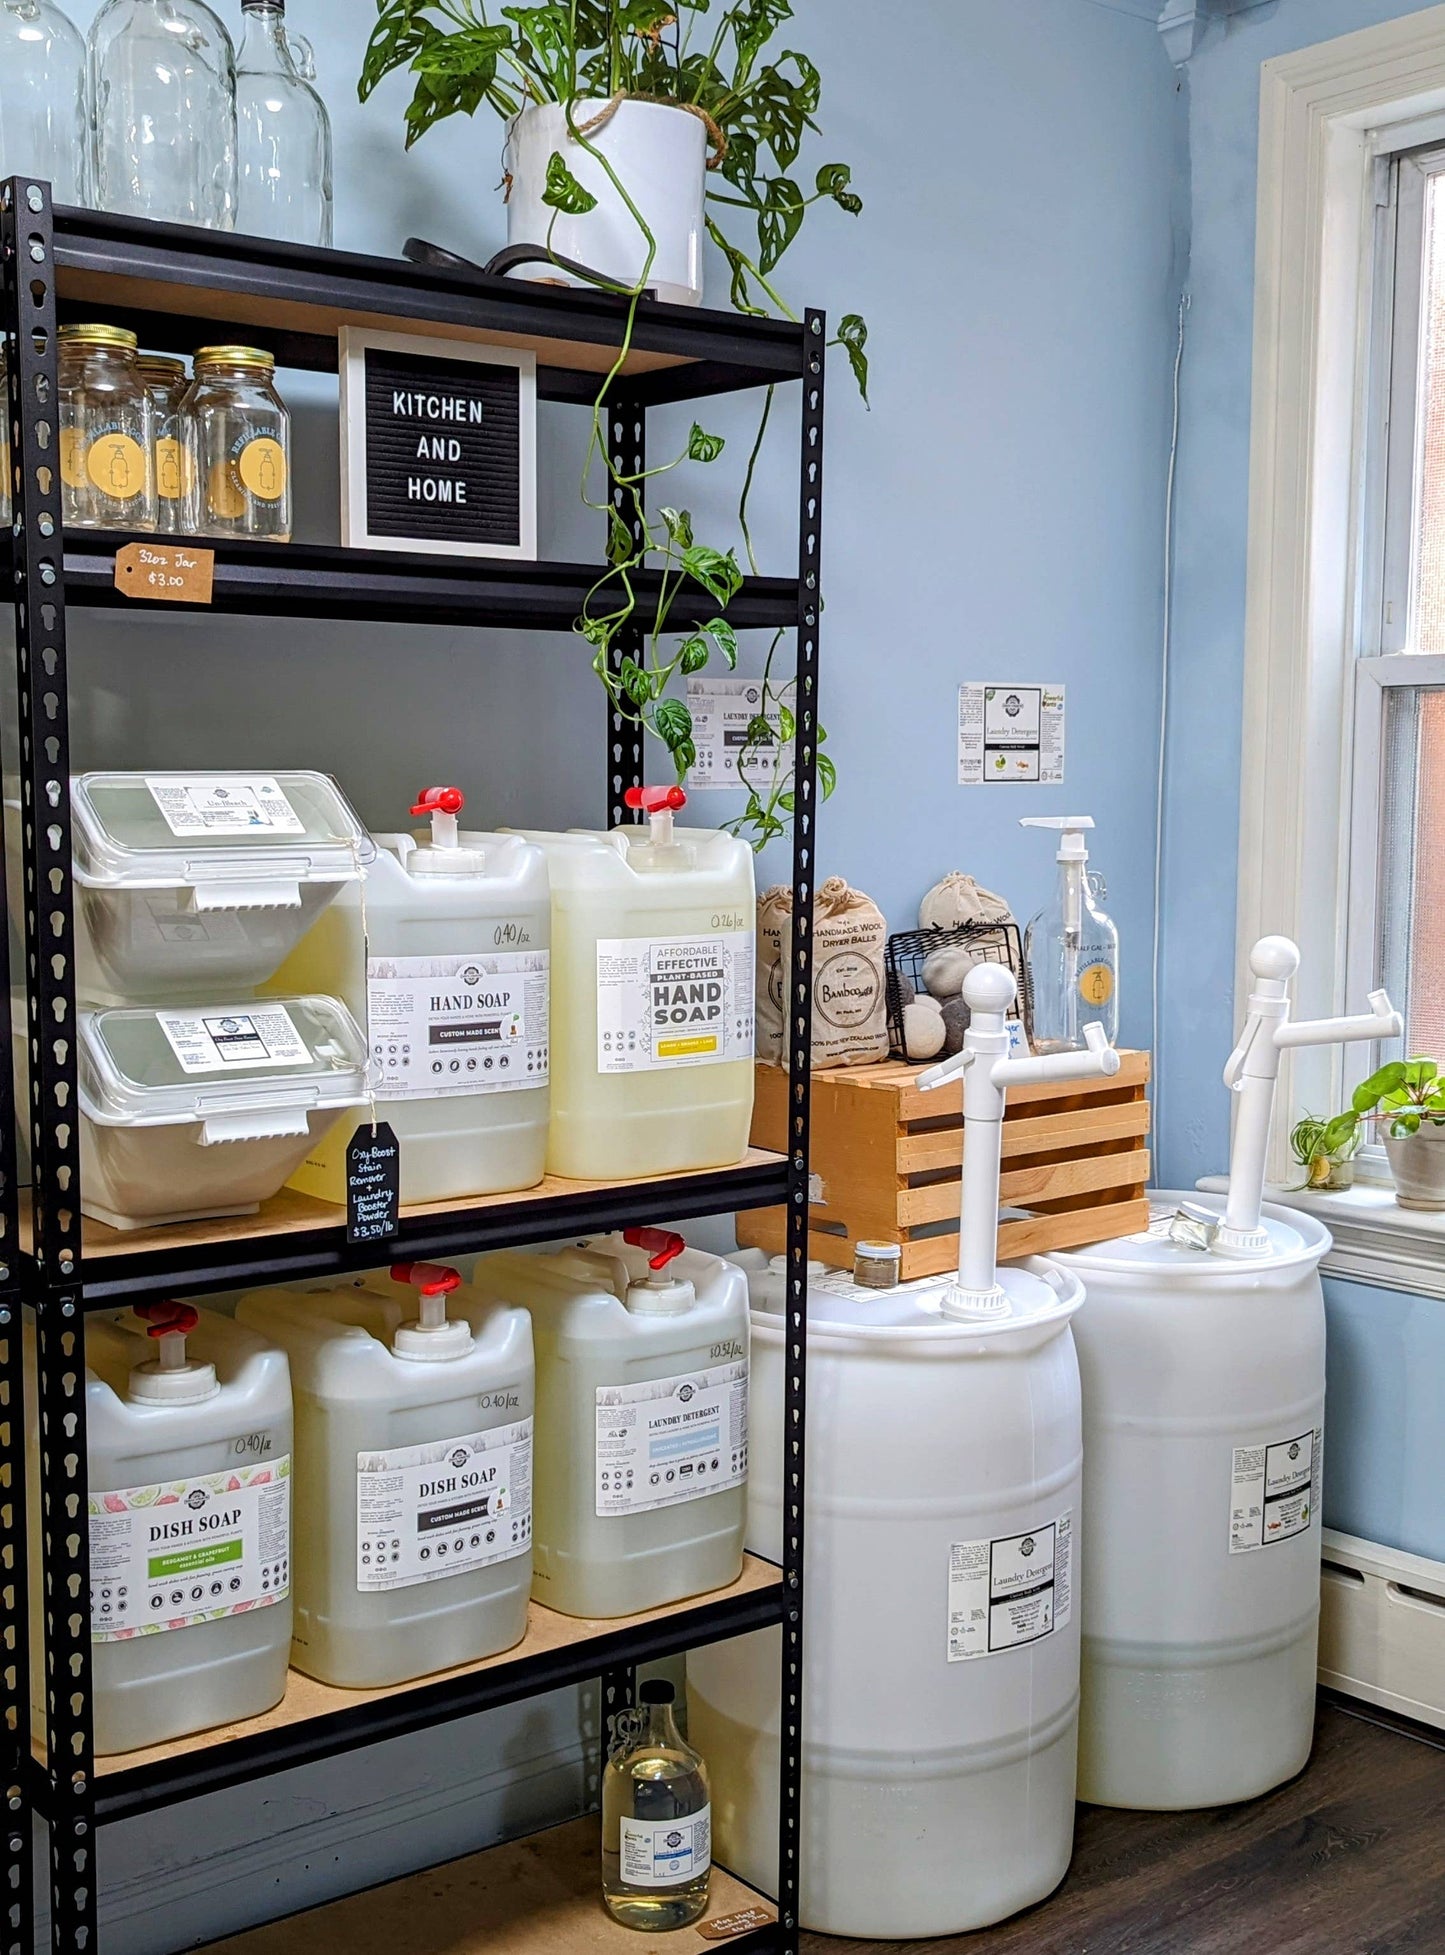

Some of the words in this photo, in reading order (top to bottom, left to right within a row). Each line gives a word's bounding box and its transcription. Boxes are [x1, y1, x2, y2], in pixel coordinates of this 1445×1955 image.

[393, 391, 482, 424] KITCHEN
[416, 436, 461, 461] AND
[408, 477, 467, 503] HOME
[139, 549, 168, 566] 32oz
[175, 553, 197, 568] Jar
[148, 571, 184, 586] $3.00
[813, 926, 859, 938] HANDMADE
[859, 922, 883, 932] WOOL
[822, 938, 850, 948] DRYER
[851, 934, 877, 945] BALLS
[657, 945, 718, 957] AFFORDABLE
[657, 957, 718, 970] EFFECTIVE
[657, 971, 718, 981] PLANT-BASED
[430, 995, 473, 1011] HAND
[477, 992, 510, 1009] SOAP
[654, 982, 721, 1006] HAND
[654, 1005, 721, 1025] SOAP
[440, 1030, 465, 1038] CUSTOM
[466, 1028, 483, 1036] MADE
[358, 1162, 382, 1173] Stain
[349, 1173, 387, 1187] Remover
[352, 1188, 394, 1204] Laundry
[357, 1200, 389, 1213] Booster
[357, 1210, 390, 1223] Powder
[481, 1392, 520, 1410] 0.40/oz
[648, 1415, 681, 1429] LAUNDRY
[683, 1404, 720, 1422] DETERGENT
[419, 1477, 456, 1498] DISH
[461, 1467, 497, 1489] SOAP
[430, 1512, 454, 1523] CUSTOM
[454, 1508, 470, 1518] MADE
[471, 1504, 487, 1514] SCENT
[149, 1519, 193, 1542] DISH
[199, 1509, 242, 1532] SOAP
[162, 1556, 192, 1566] BERGAMOT
[198, 1546, 230, 1558] GRAPEFRUIT
[994, 1572, 1024, 1586] Laundry
